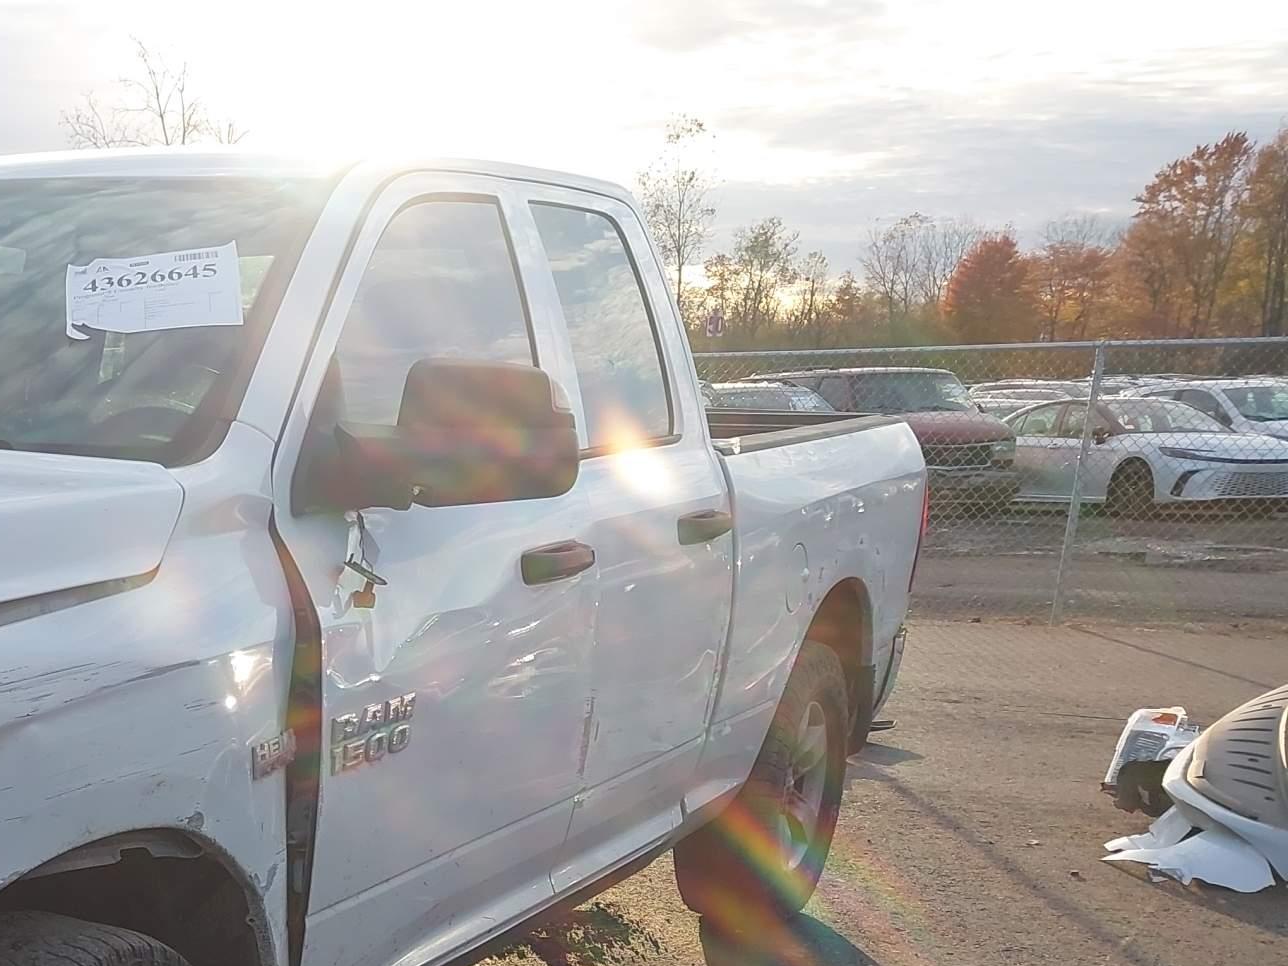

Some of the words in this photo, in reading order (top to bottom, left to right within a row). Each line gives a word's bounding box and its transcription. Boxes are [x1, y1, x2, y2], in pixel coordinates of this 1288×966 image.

[82, 262, 218, 293] 43626645
[331, 691, 416, 744] RAM
[331, 724, 411, 776] 1500
